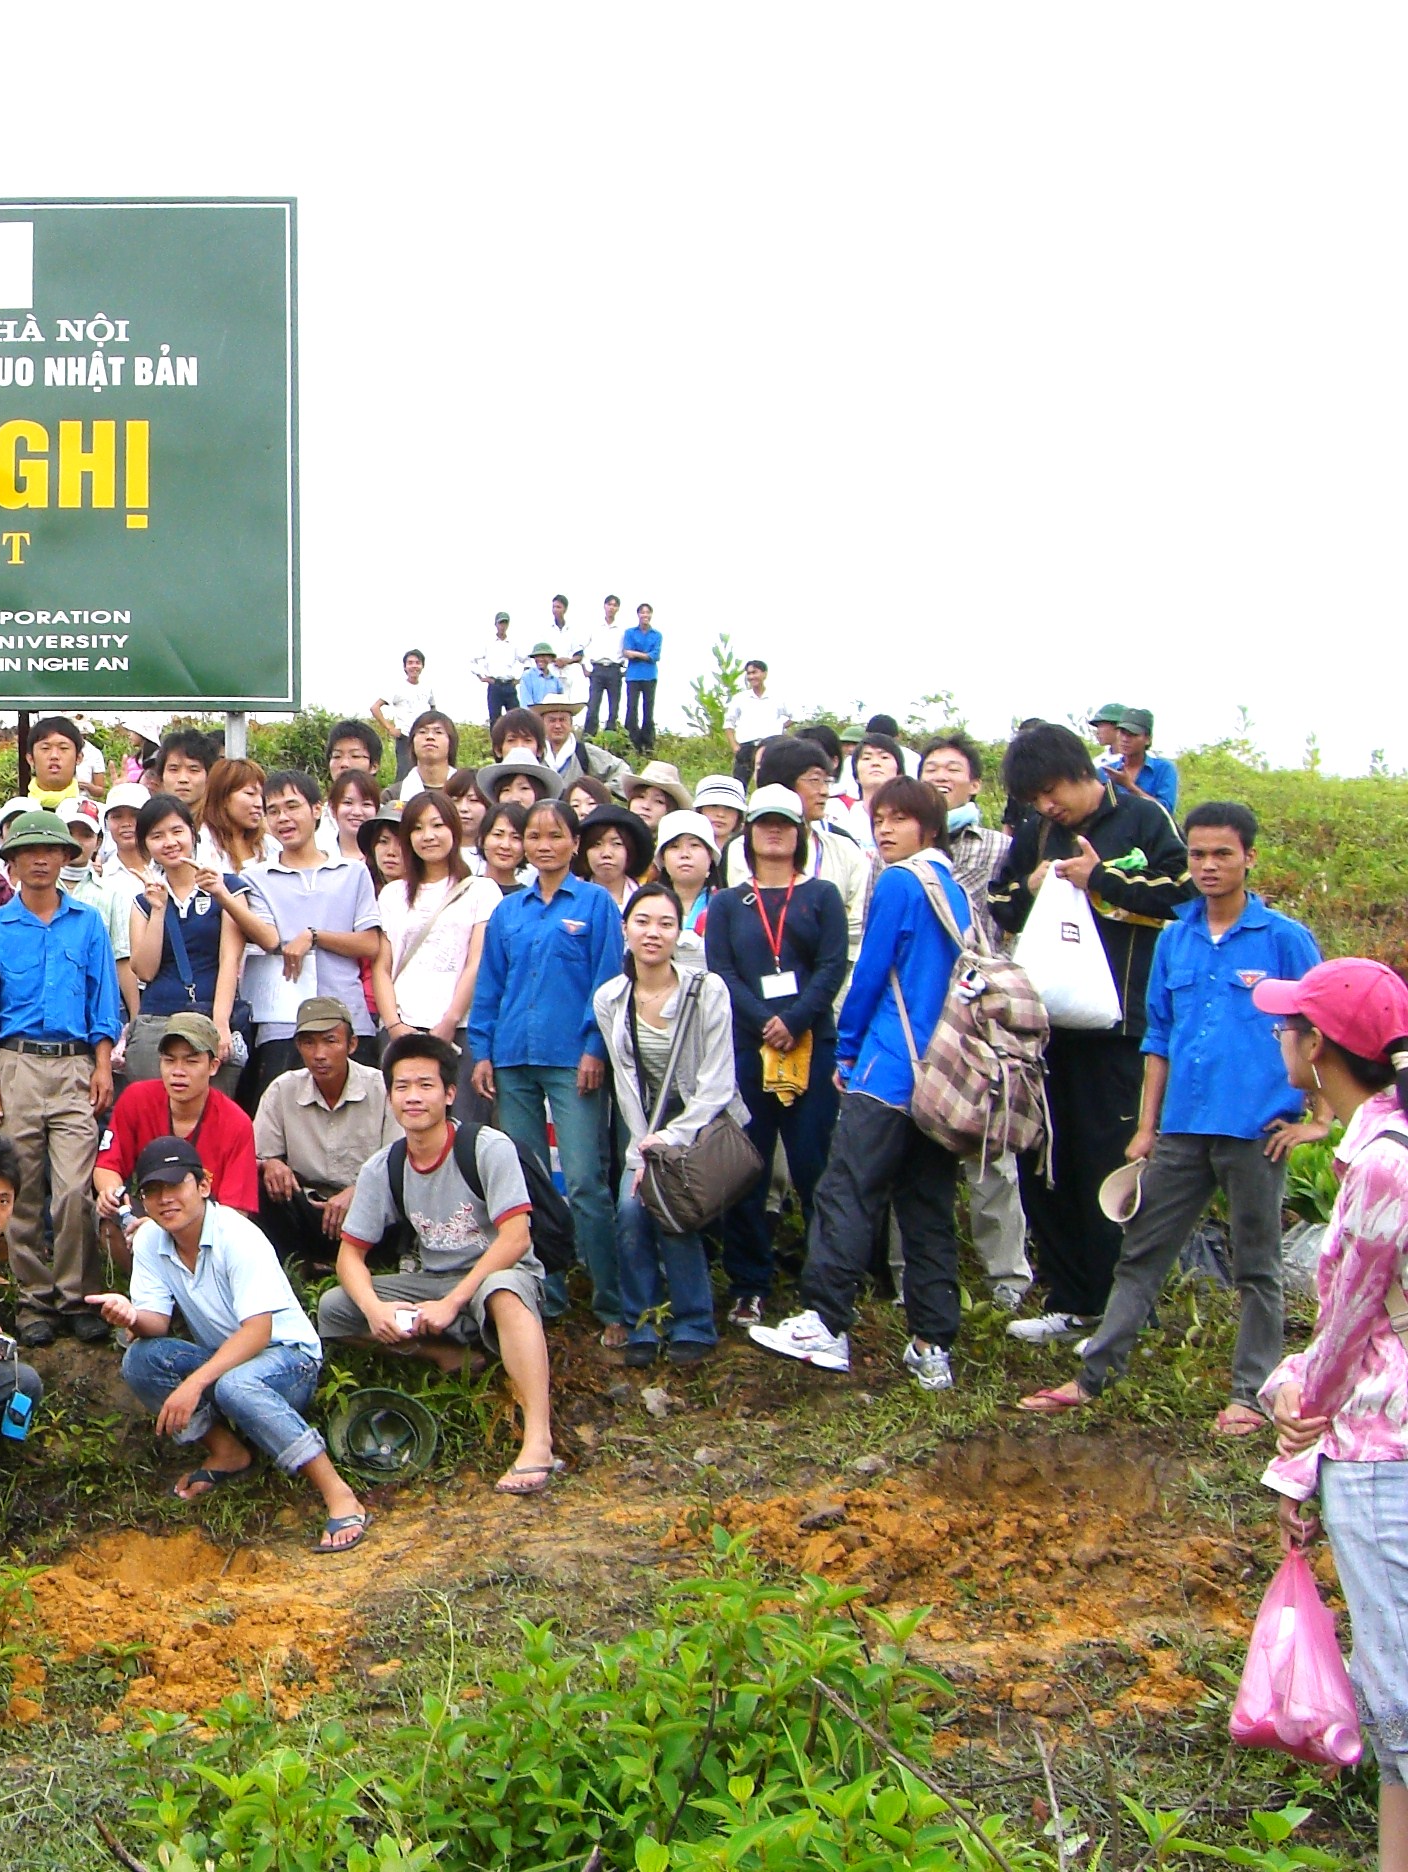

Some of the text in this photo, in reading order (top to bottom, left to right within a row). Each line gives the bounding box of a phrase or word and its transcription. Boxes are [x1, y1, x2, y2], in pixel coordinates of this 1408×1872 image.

[56, 313, 129, 347] NỘI
[45, 351, 125, 392] NHẬT
[135, 344, 197, 385] BẢN
[0, 658, 20, 671] IN
[28, 658, 88, 671] NGHE
[95, 658, 128, 670] AN
